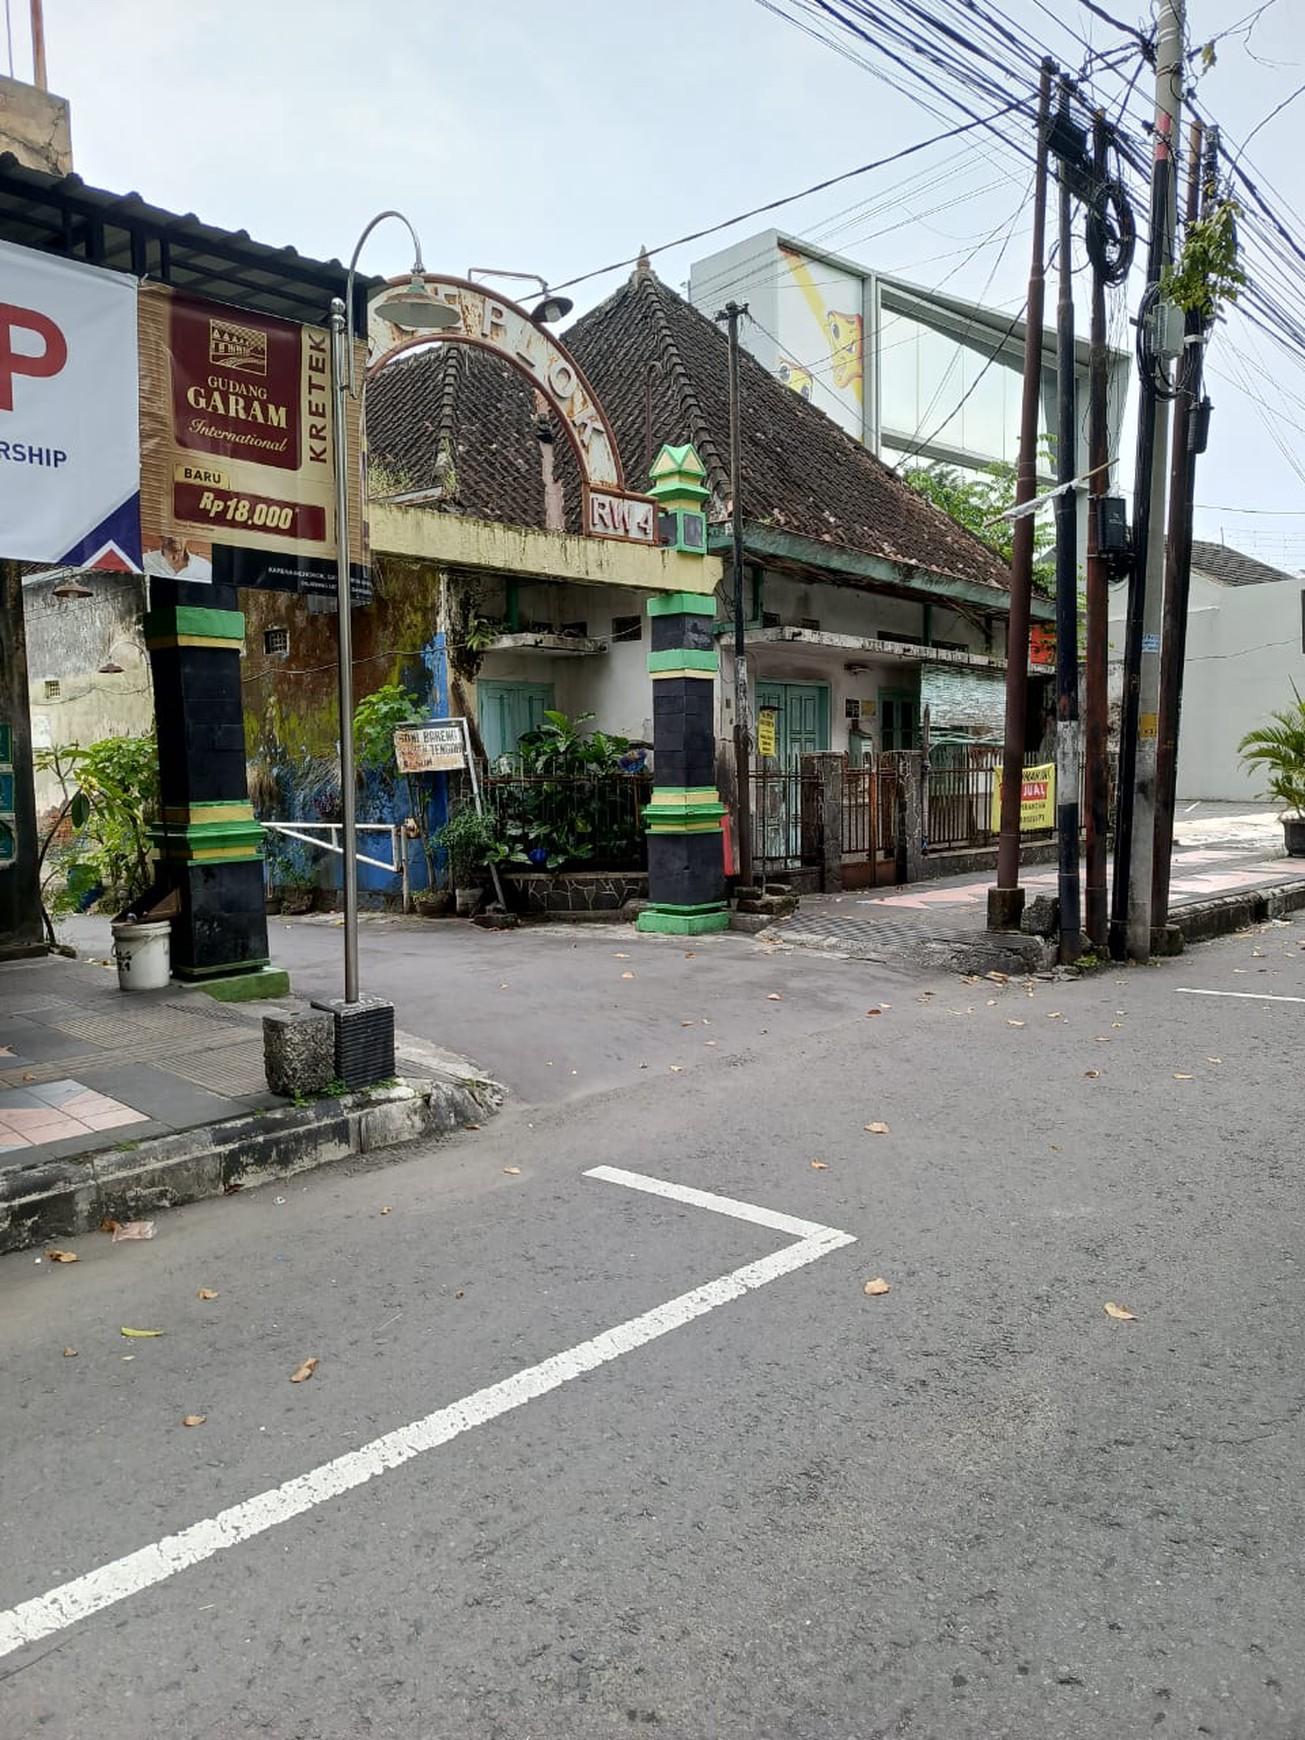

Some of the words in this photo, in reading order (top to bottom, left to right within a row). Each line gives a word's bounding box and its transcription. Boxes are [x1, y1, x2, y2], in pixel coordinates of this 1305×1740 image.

[207, 375, 268, 400] GUDANG
[308, 333, 327, 464] KRETEK
[186, 386, 288, 429] GARAM
[188, 418, 289, 452] International
[184, 467, 222, 484] BARU
[591, 496, 632, 532] RW
[636, 508, 653, 535] 4
